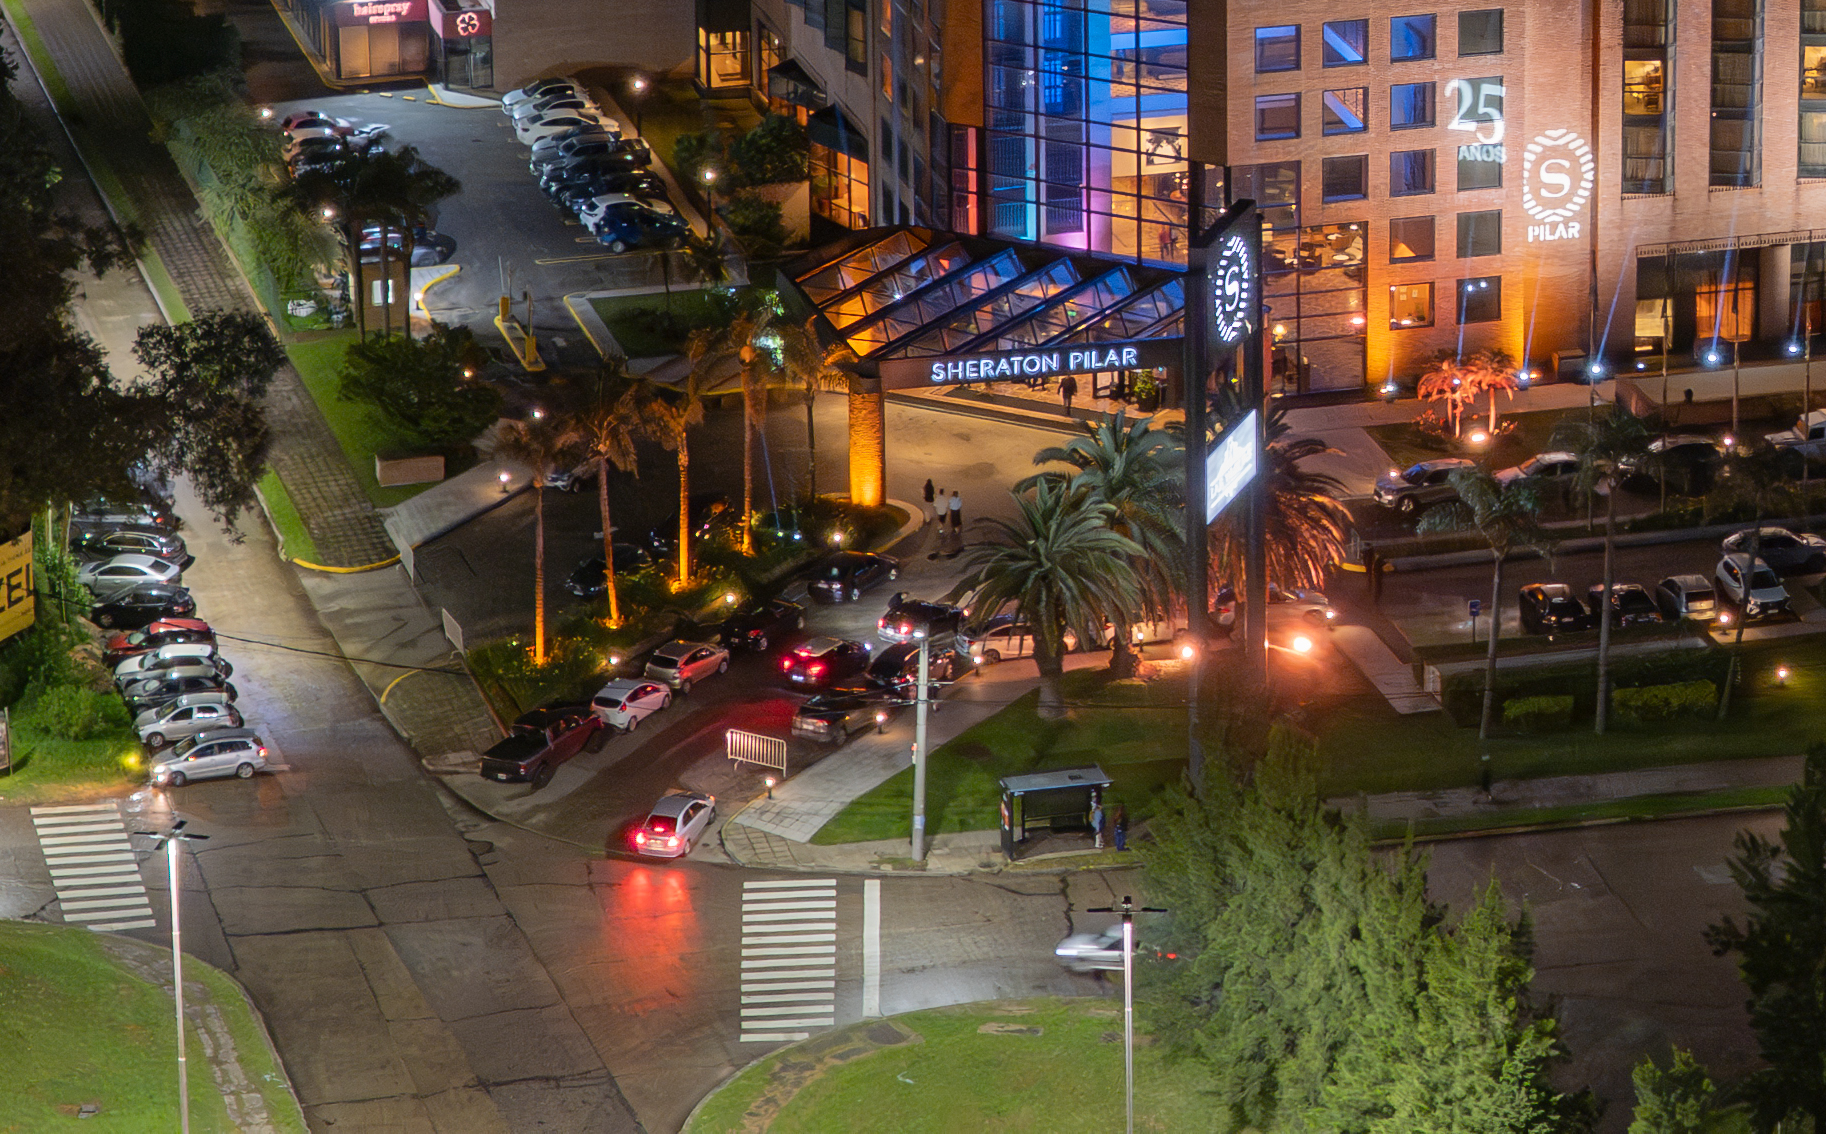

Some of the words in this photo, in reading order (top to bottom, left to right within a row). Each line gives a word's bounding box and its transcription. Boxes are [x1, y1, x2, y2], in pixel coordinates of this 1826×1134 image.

[1444, 78, 1506, 145] 25
[1539, 159, 1571, 198] S
[1527, 222, 1581, 243] PILAR
[931, 352, 1060, 382] SHERATON
[1069, 346, 1138, 370] PILAR
